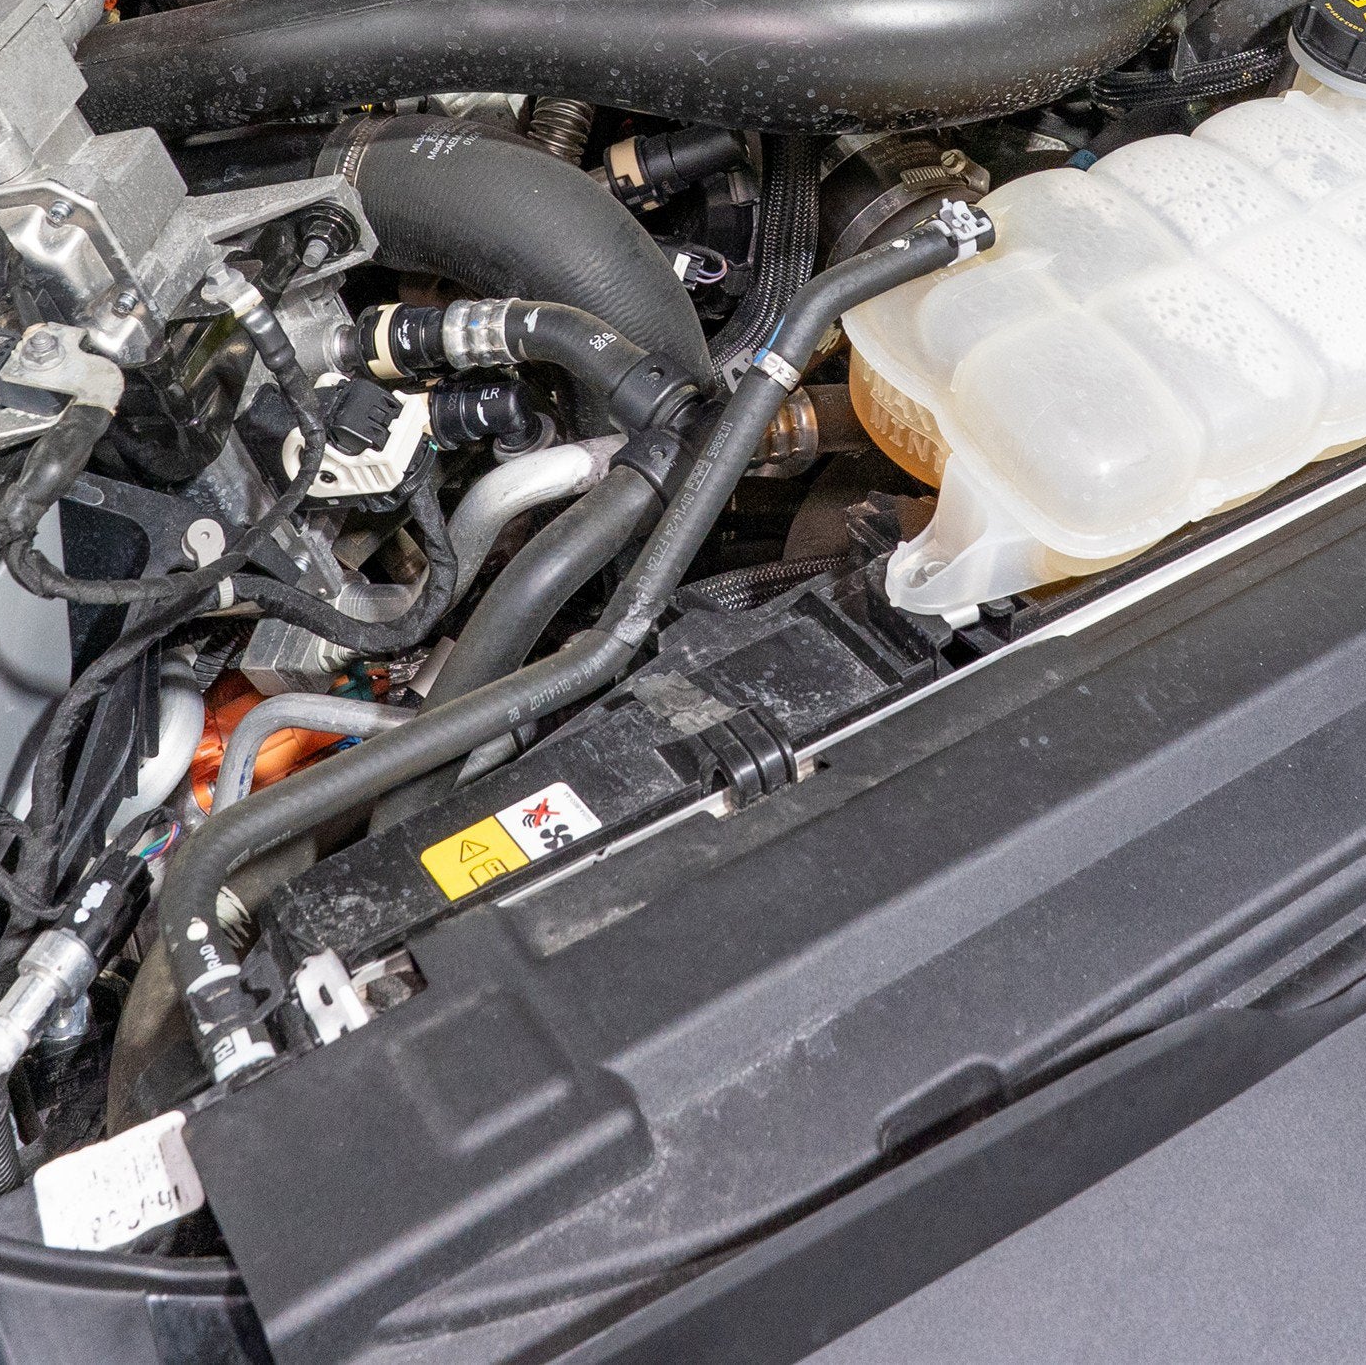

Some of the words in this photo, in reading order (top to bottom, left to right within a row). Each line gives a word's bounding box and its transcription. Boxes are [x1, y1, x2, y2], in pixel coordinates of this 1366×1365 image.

[589, 335, 608, 351] ISC
[602, 332, 617, 344] UP
[706, 421, 734, 459] 1036865
[869, 399, 932, 463] MIN
[664, 492, 695, 535] 01/14/24
[529, 678, 571, 711] 01:41:07
[199, 943, 223, 971] RAD
